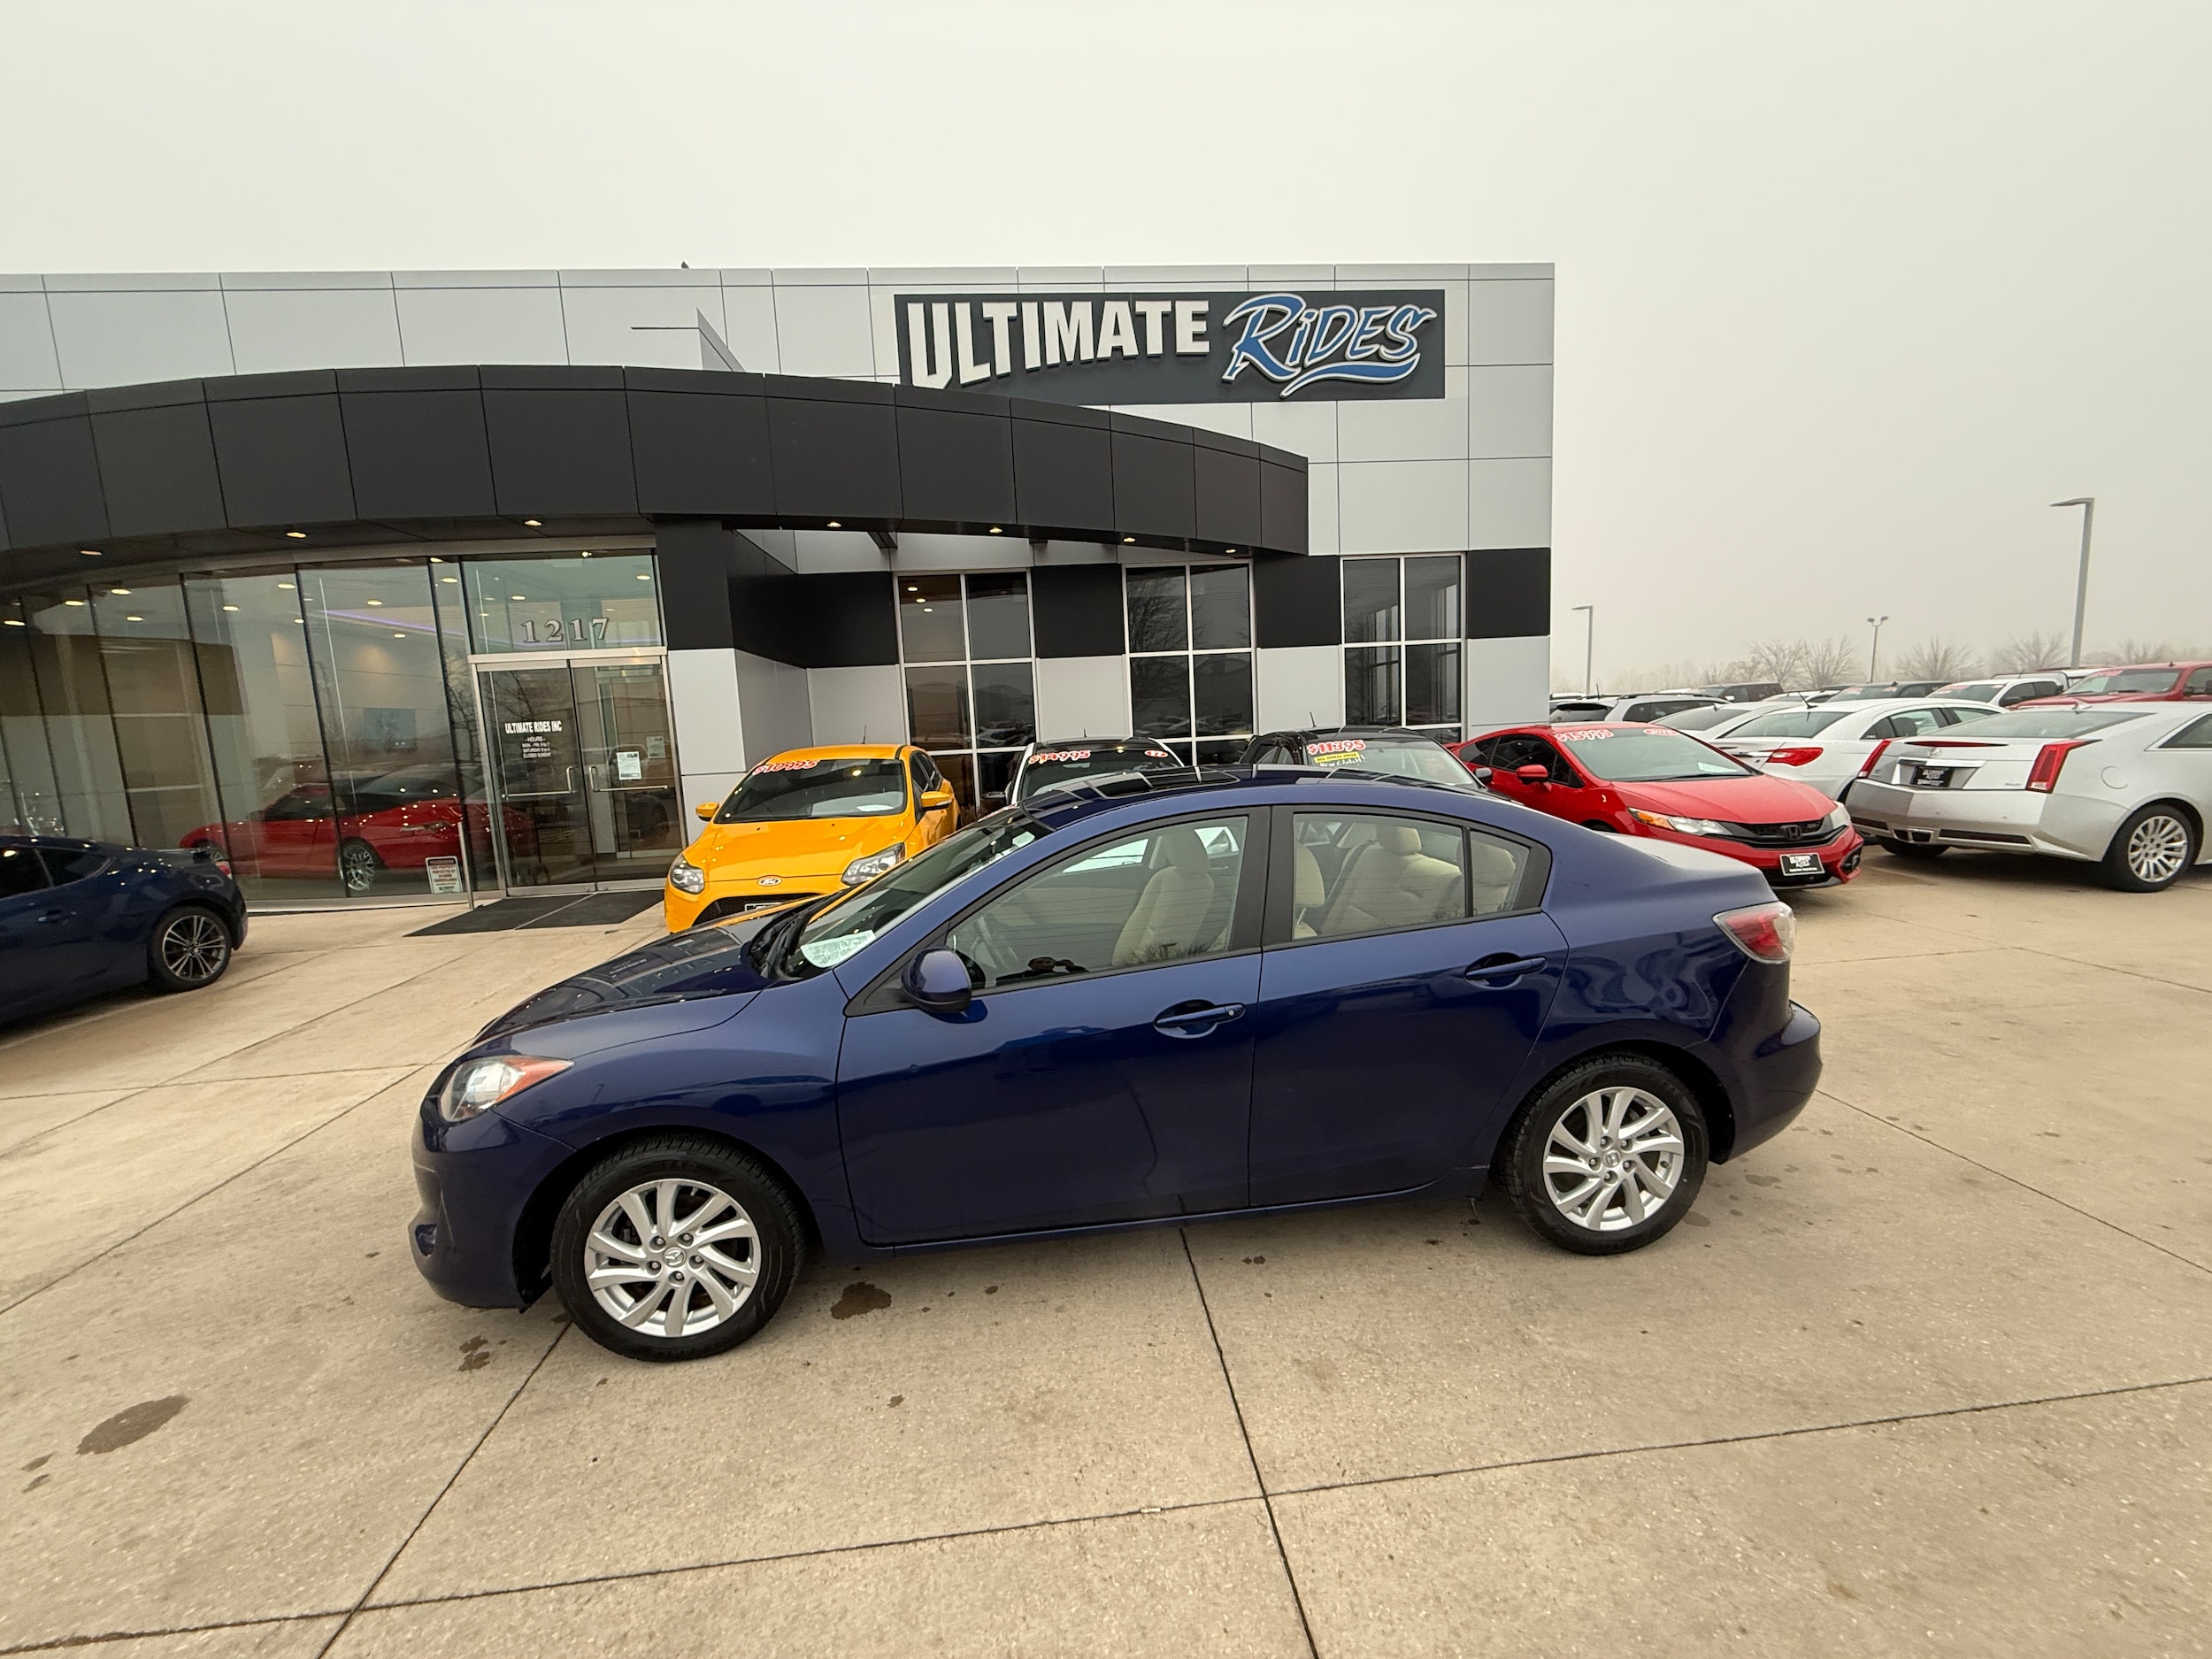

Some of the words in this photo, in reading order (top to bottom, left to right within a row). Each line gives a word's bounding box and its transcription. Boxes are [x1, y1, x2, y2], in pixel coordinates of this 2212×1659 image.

[907, 300, 1210, 389] ULTIMATE
[521, 618, 609, 642] 1217
[504, 721, 534, 734] ULTIMATE
[534, 720, 551, 733] RIDES
[551, 719, 563, 732] INC
[1307, 740, 1366, 755] $11395
[1028, 749, 1092, 764] $14995
